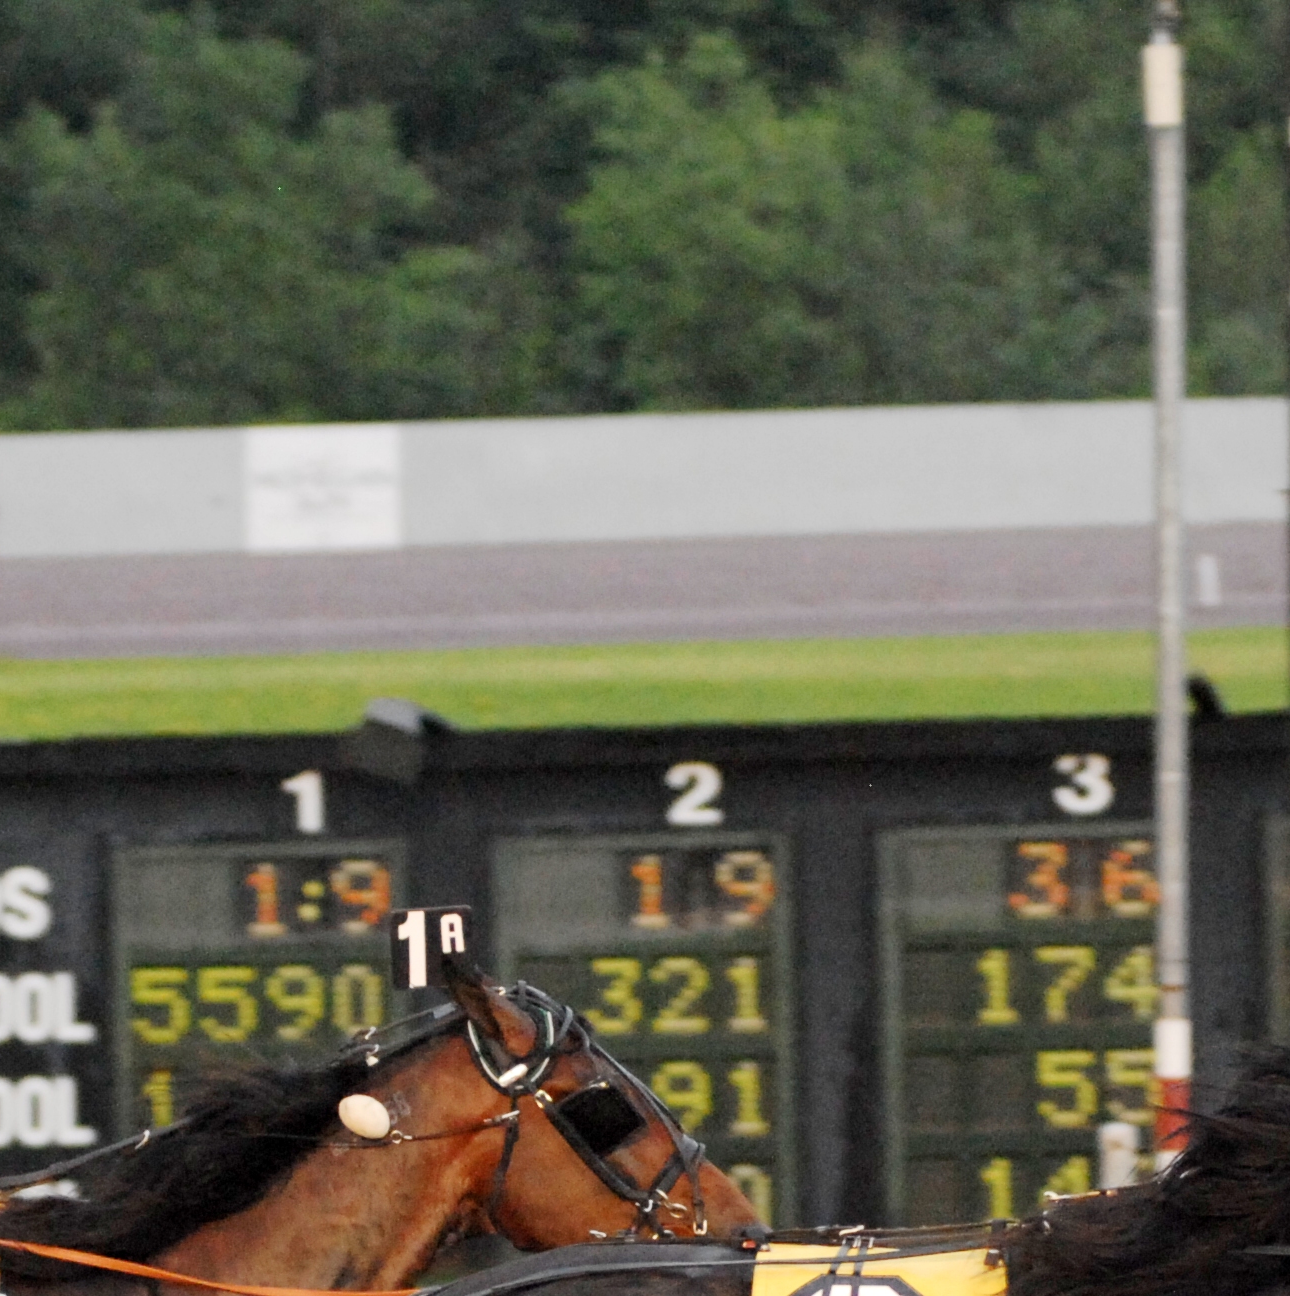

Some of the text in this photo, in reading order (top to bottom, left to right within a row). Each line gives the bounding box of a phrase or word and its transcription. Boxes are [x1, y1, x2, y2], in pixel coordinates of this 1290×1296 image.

[281, 771, 325, 833] 1
[664, 761, 725, 827] 2
[1051, 754, 1115, 815] 3
[130, 964, 385, 1044] 5590
[588, 957, 766, 1035] 321
[975, 945, 1160, 1025] 174
